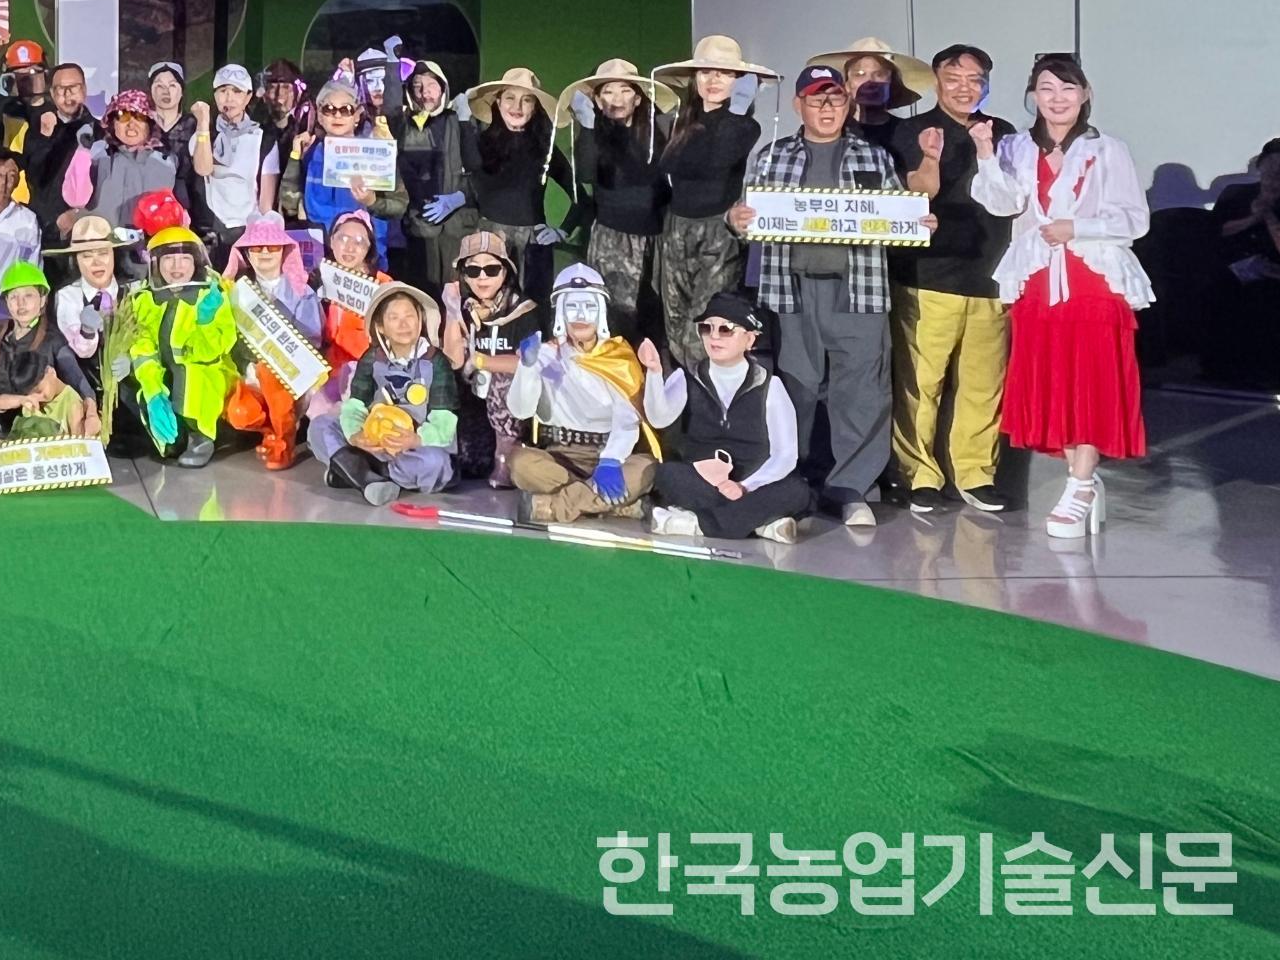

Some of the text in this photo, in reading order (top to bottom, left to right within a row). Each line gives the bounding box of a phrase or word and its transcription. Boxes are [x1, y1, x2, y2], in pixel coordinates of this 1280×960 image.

[794, 198, 880, 215] 농부의 지혜,
[757, 217, 799, 232] 이제는
